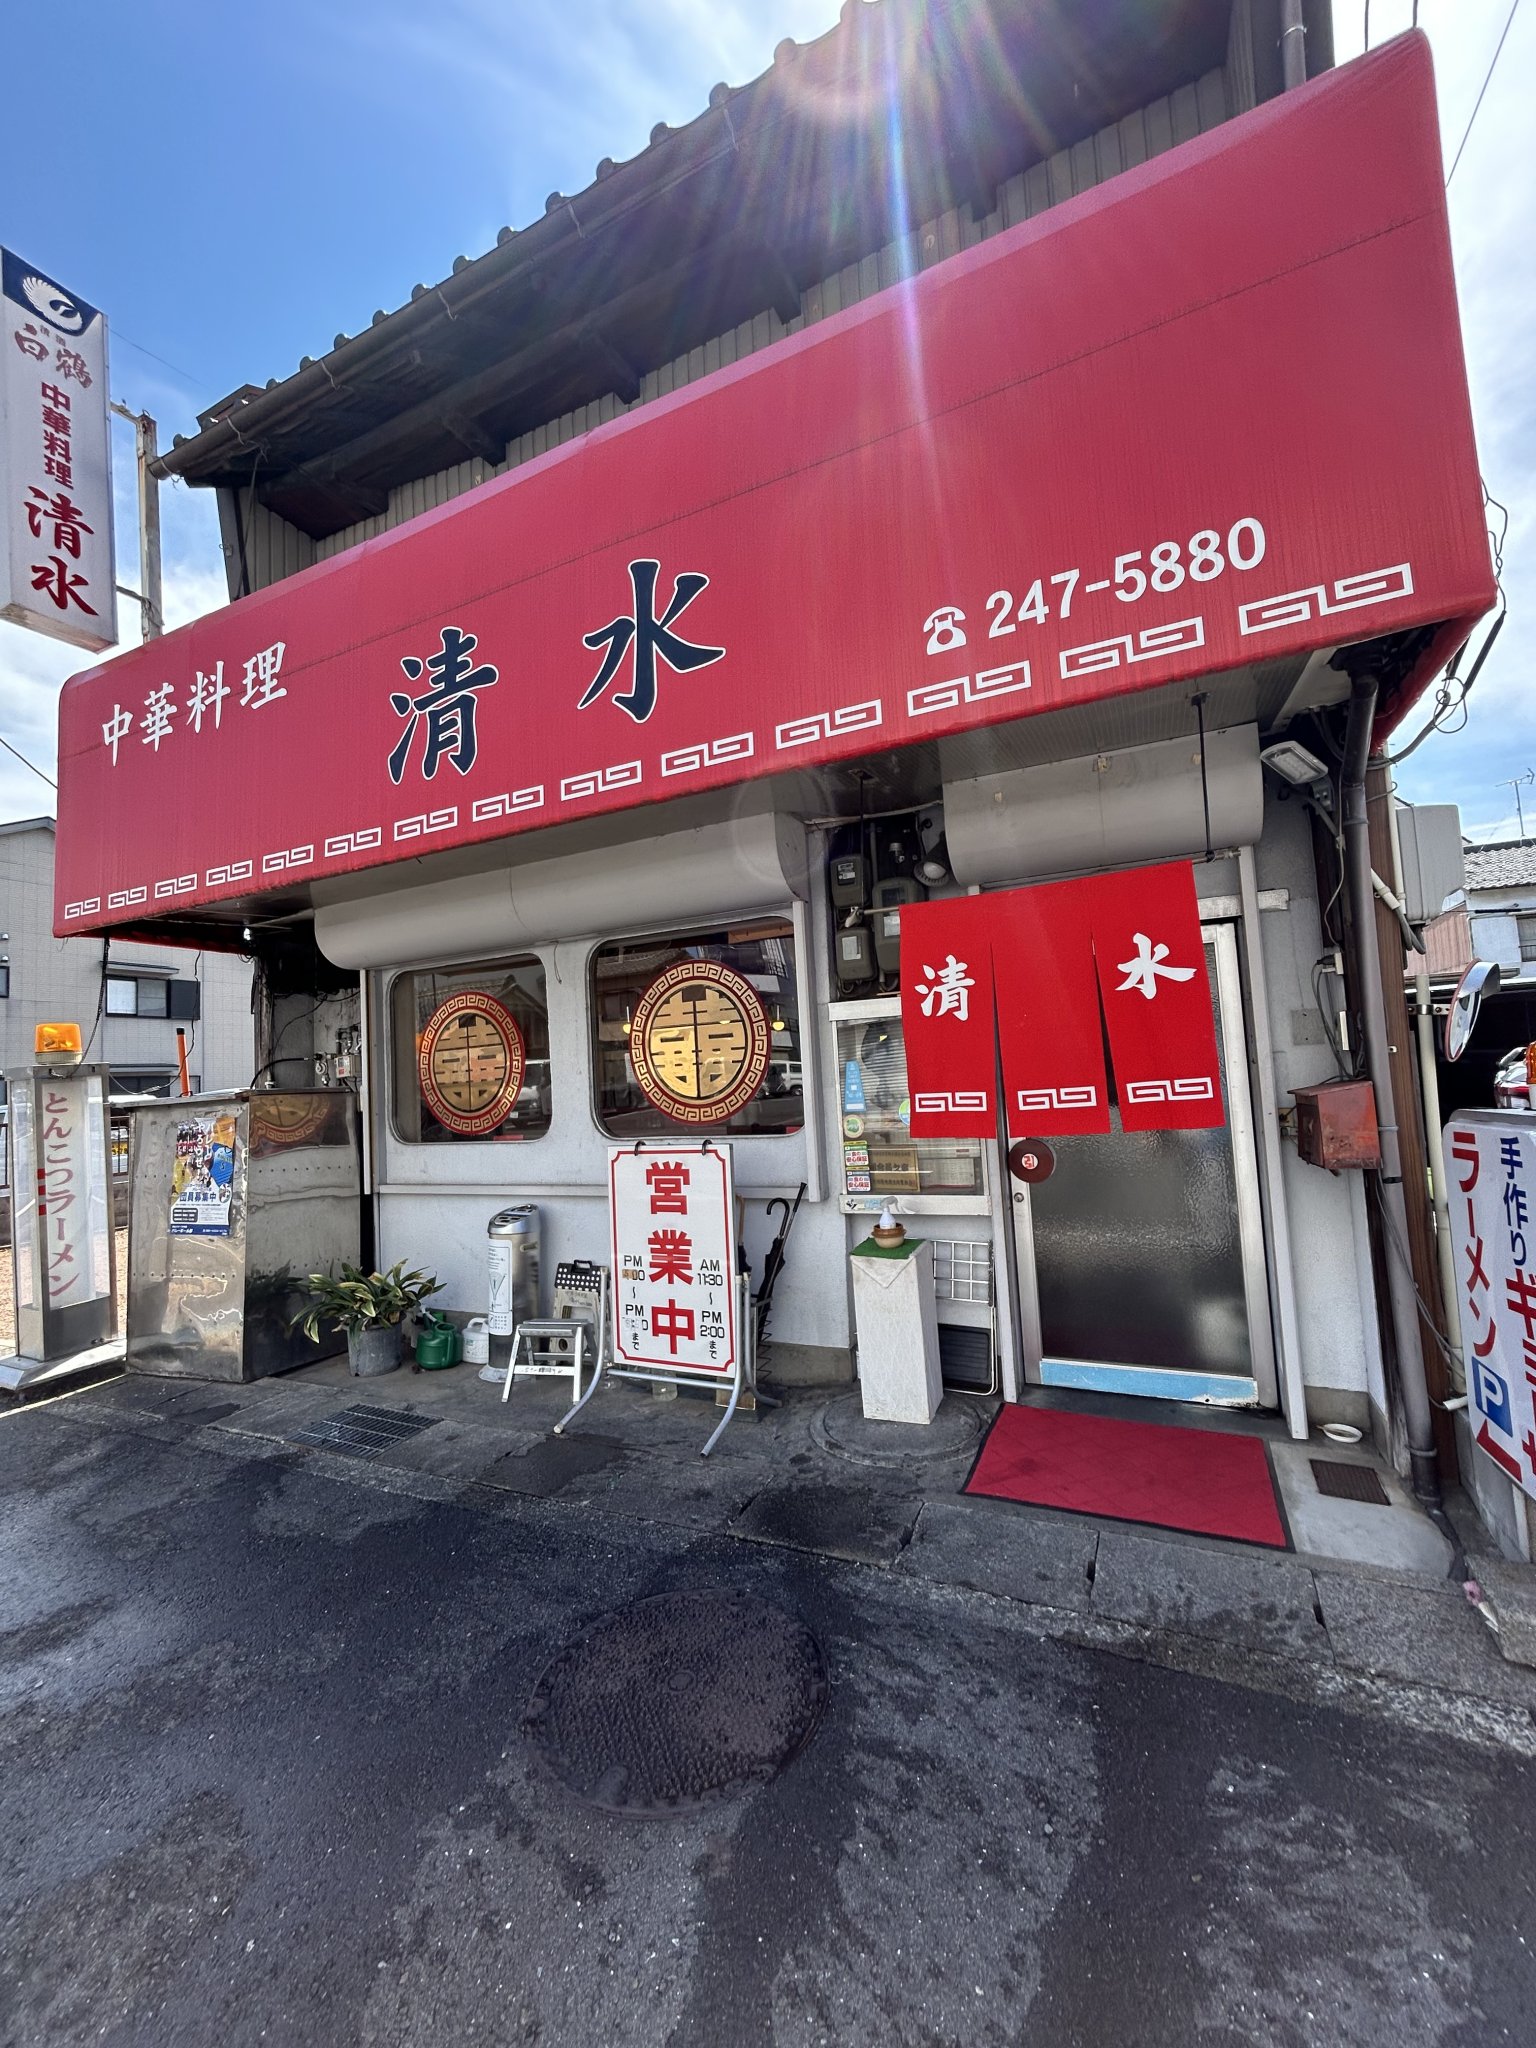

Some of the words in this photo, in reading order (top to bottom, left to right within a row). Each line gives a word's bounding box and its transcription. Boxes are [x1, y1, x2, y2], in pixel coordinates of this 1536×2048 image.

[14, 322, 93, 389] 白鶴
[41, 382, 74, 490] 中華料理
[23, 485, 99, 617] 清水
[985, 516, 1266, 639] 247-5880
[101, 641, 288, 767] 中華料理
[387, 557, 727, 786] 清水
[43, 1092, 80, 1297] とんこつラーメン
[623, 1255, 643, 1267] PM
[645, 1160, 695, 1354] 営業中
[700, 1259, 720, 1272] AM
[1451, 1131, 1497, 1357] ラーメン
[625, 1304, 645, 1317] PM
[697, 1273, 723, 1287] 11:30
[632, 1332, 640, 1351] まで
[700, 1324, 725, 1338] 2:00
[701, 1310, 722, 1323] PM
[708, 1340, 717, 1360] まで
